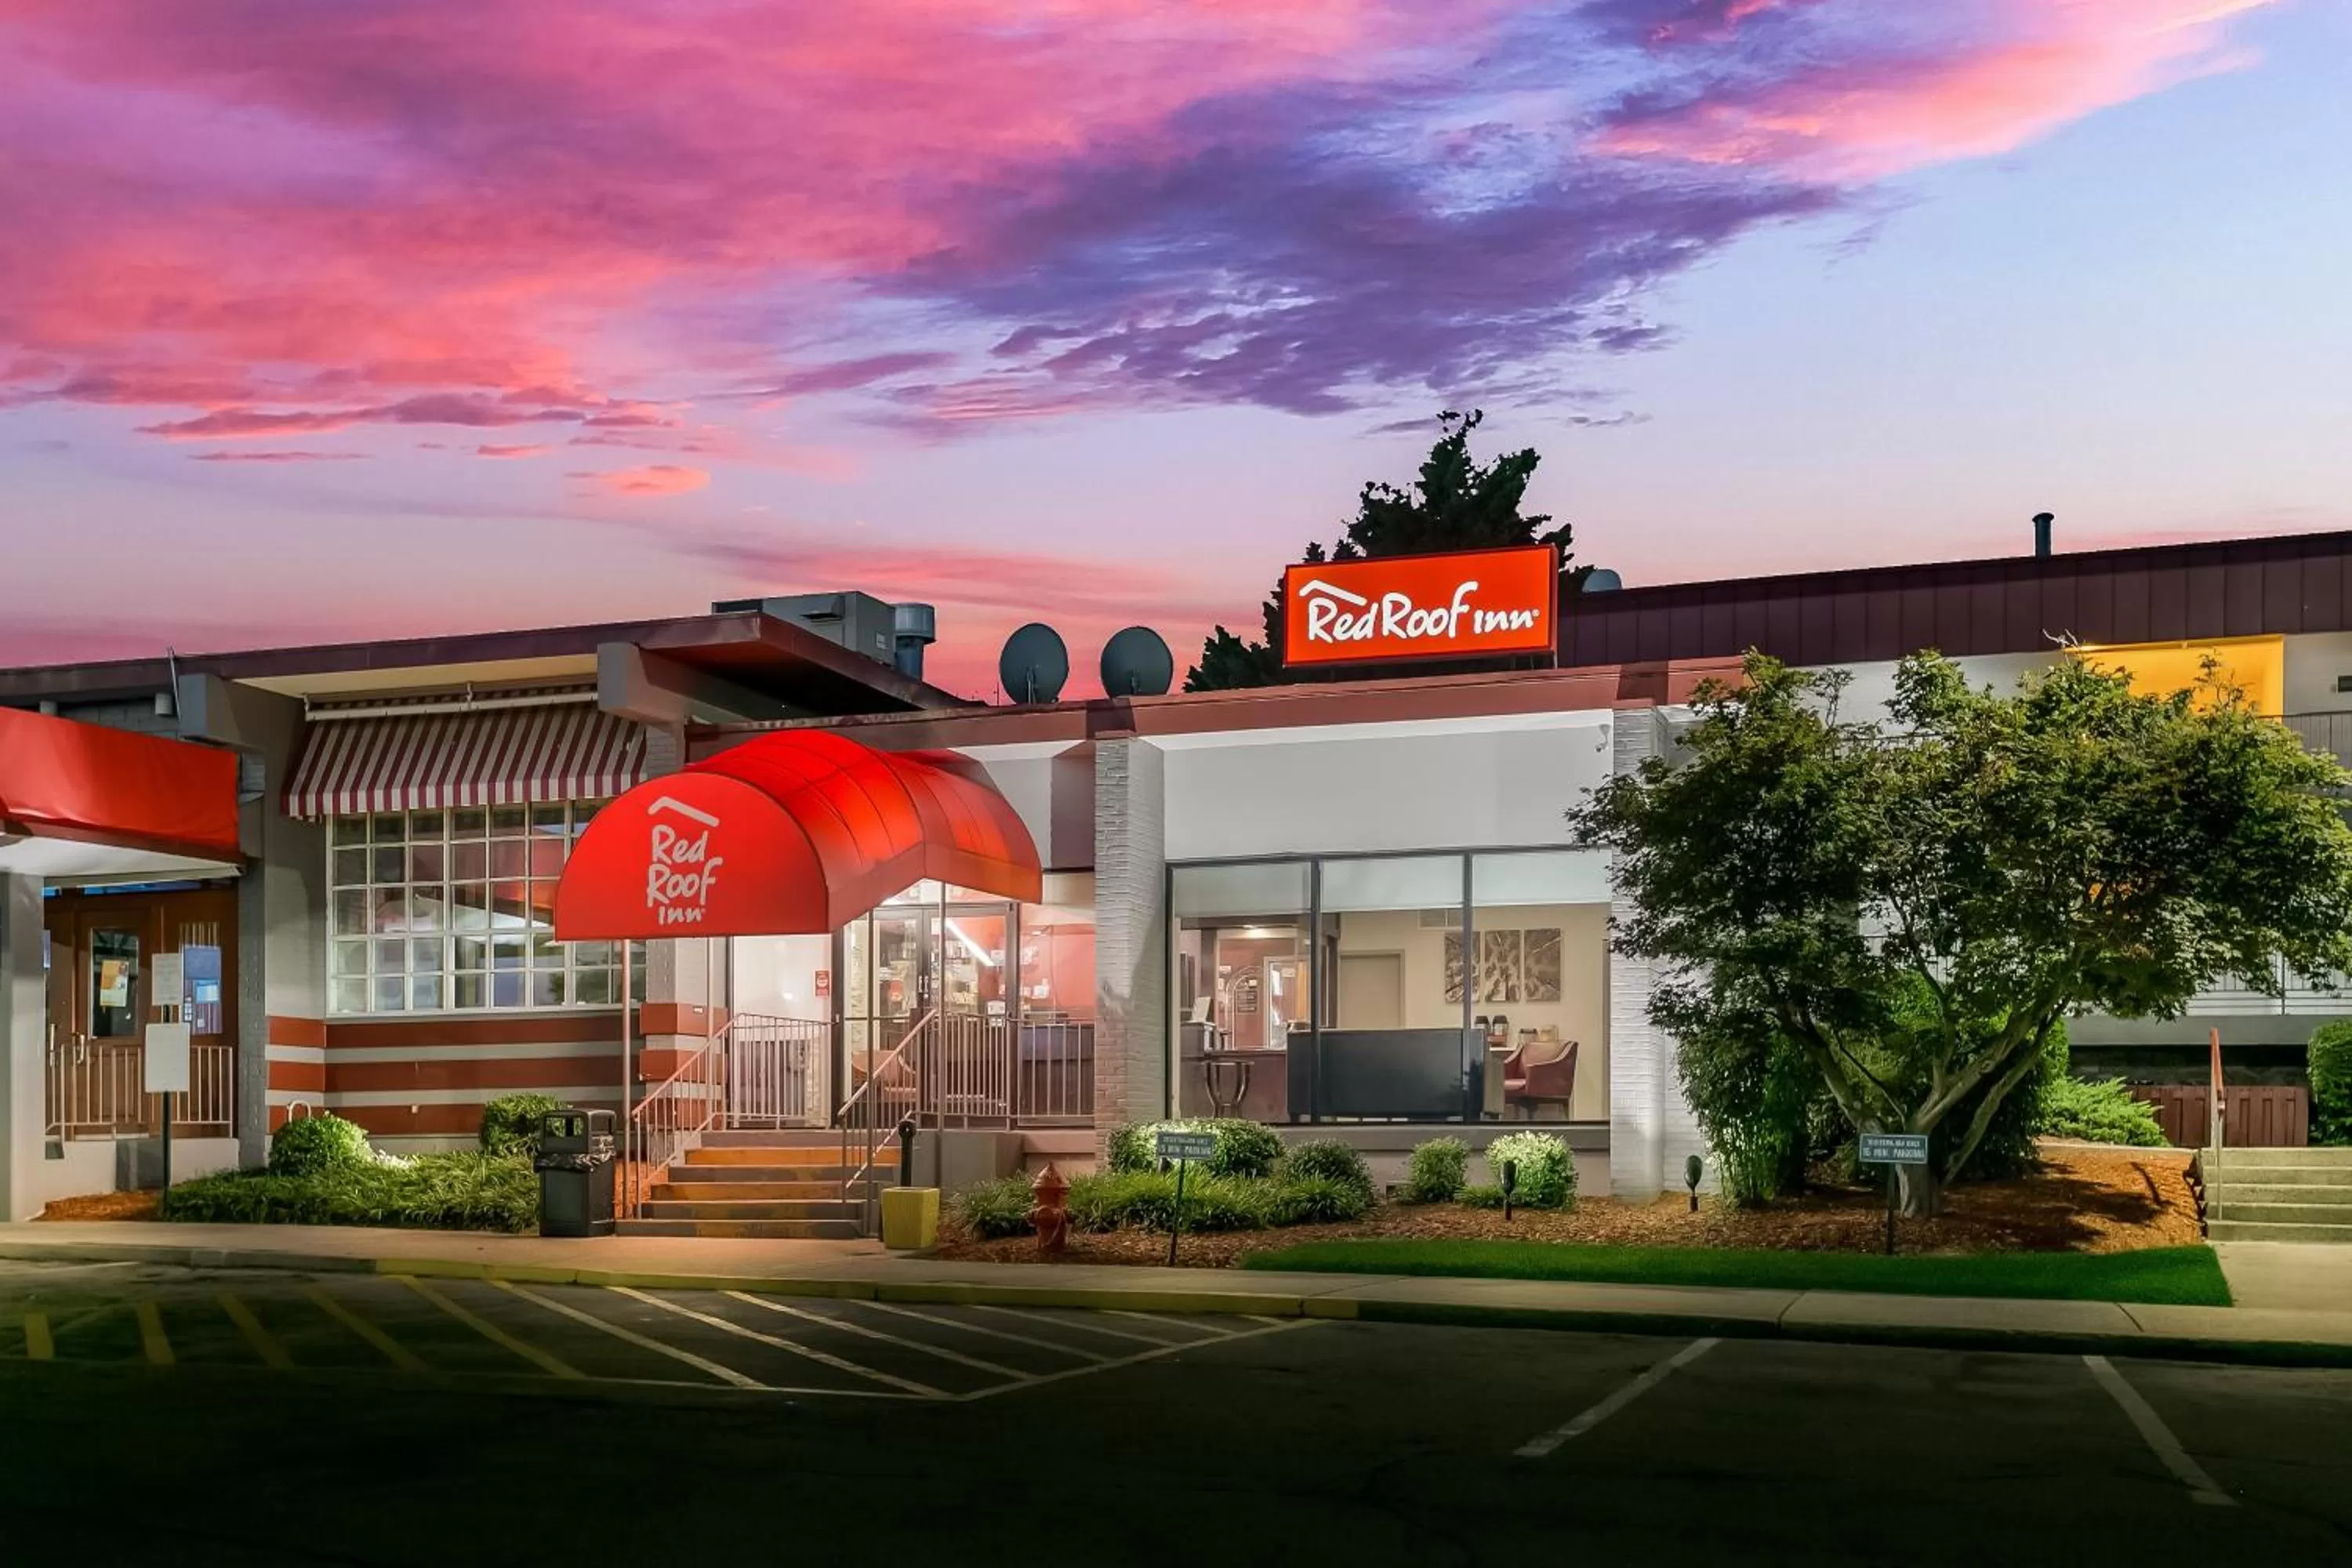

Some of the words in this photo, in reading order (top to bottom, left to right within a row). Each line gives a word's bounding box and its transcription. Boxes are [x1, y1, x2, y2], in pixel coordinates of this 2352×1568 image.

[1308, 597, 1379, 644] Red
[1381, 581, 1479, 639] Roof
[652, 824, 709, 865] Red
[646, 856, 724, 908] Roof
